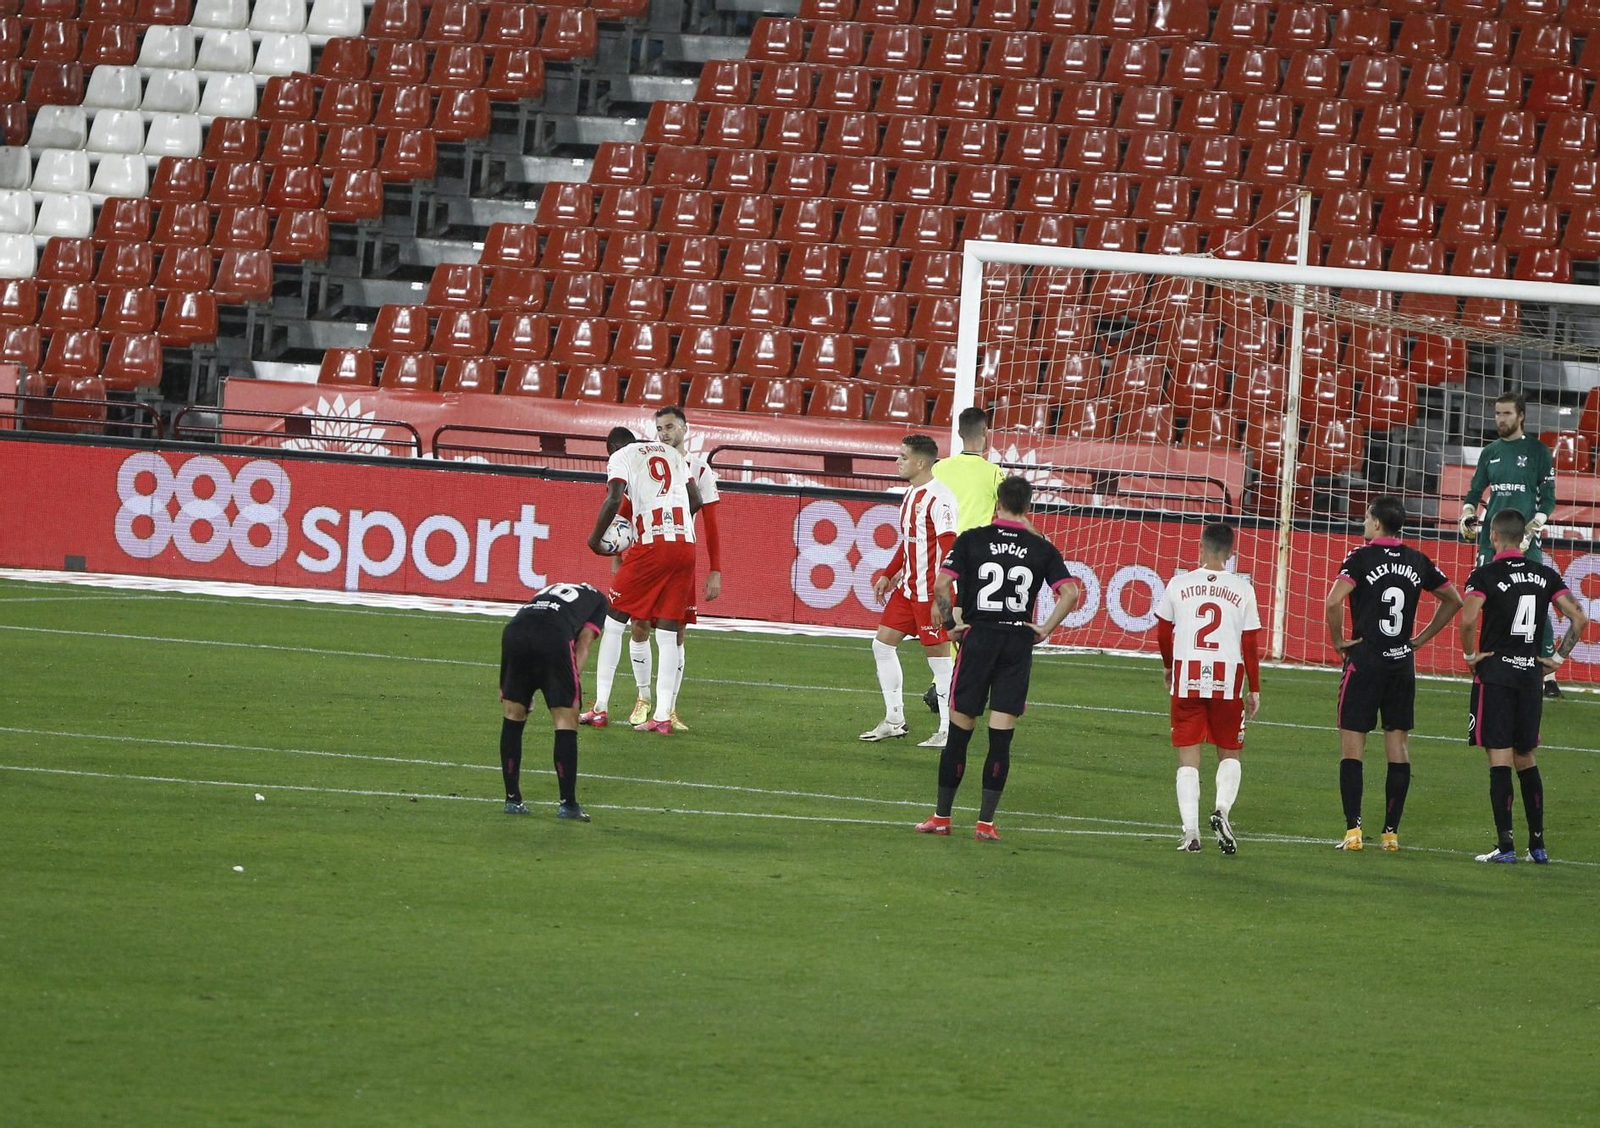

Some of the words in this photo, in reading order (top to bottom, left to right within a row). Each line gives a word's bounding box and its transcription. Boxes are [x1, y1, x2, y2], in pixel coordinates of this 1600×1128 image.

[646, 455, 672, 498] 9
[115, 451, 291, 567] 888
[297, 504, 550, 591] sport
[790, 499, 903, 613] 88
[989, 542, 1028, 559] ŠIPČIĆ
[1365, 562, 1390, 585] ALEX
[1391, 562, 1421, 587] MUÑOZ
[977, 561, 1034, 613] 23
[1180, 585, 1207, 601] AITOR
[1209, 585, 1243, 609] BUÑUEL
[1497, 581, 1512, 592] B.
[1509, 572, 1548, 589] WILSON
[1194, 601, 1222, 651] 2
[1379, 586, 1406, 637] 3
[1510, 594, 1537, 643] 4
